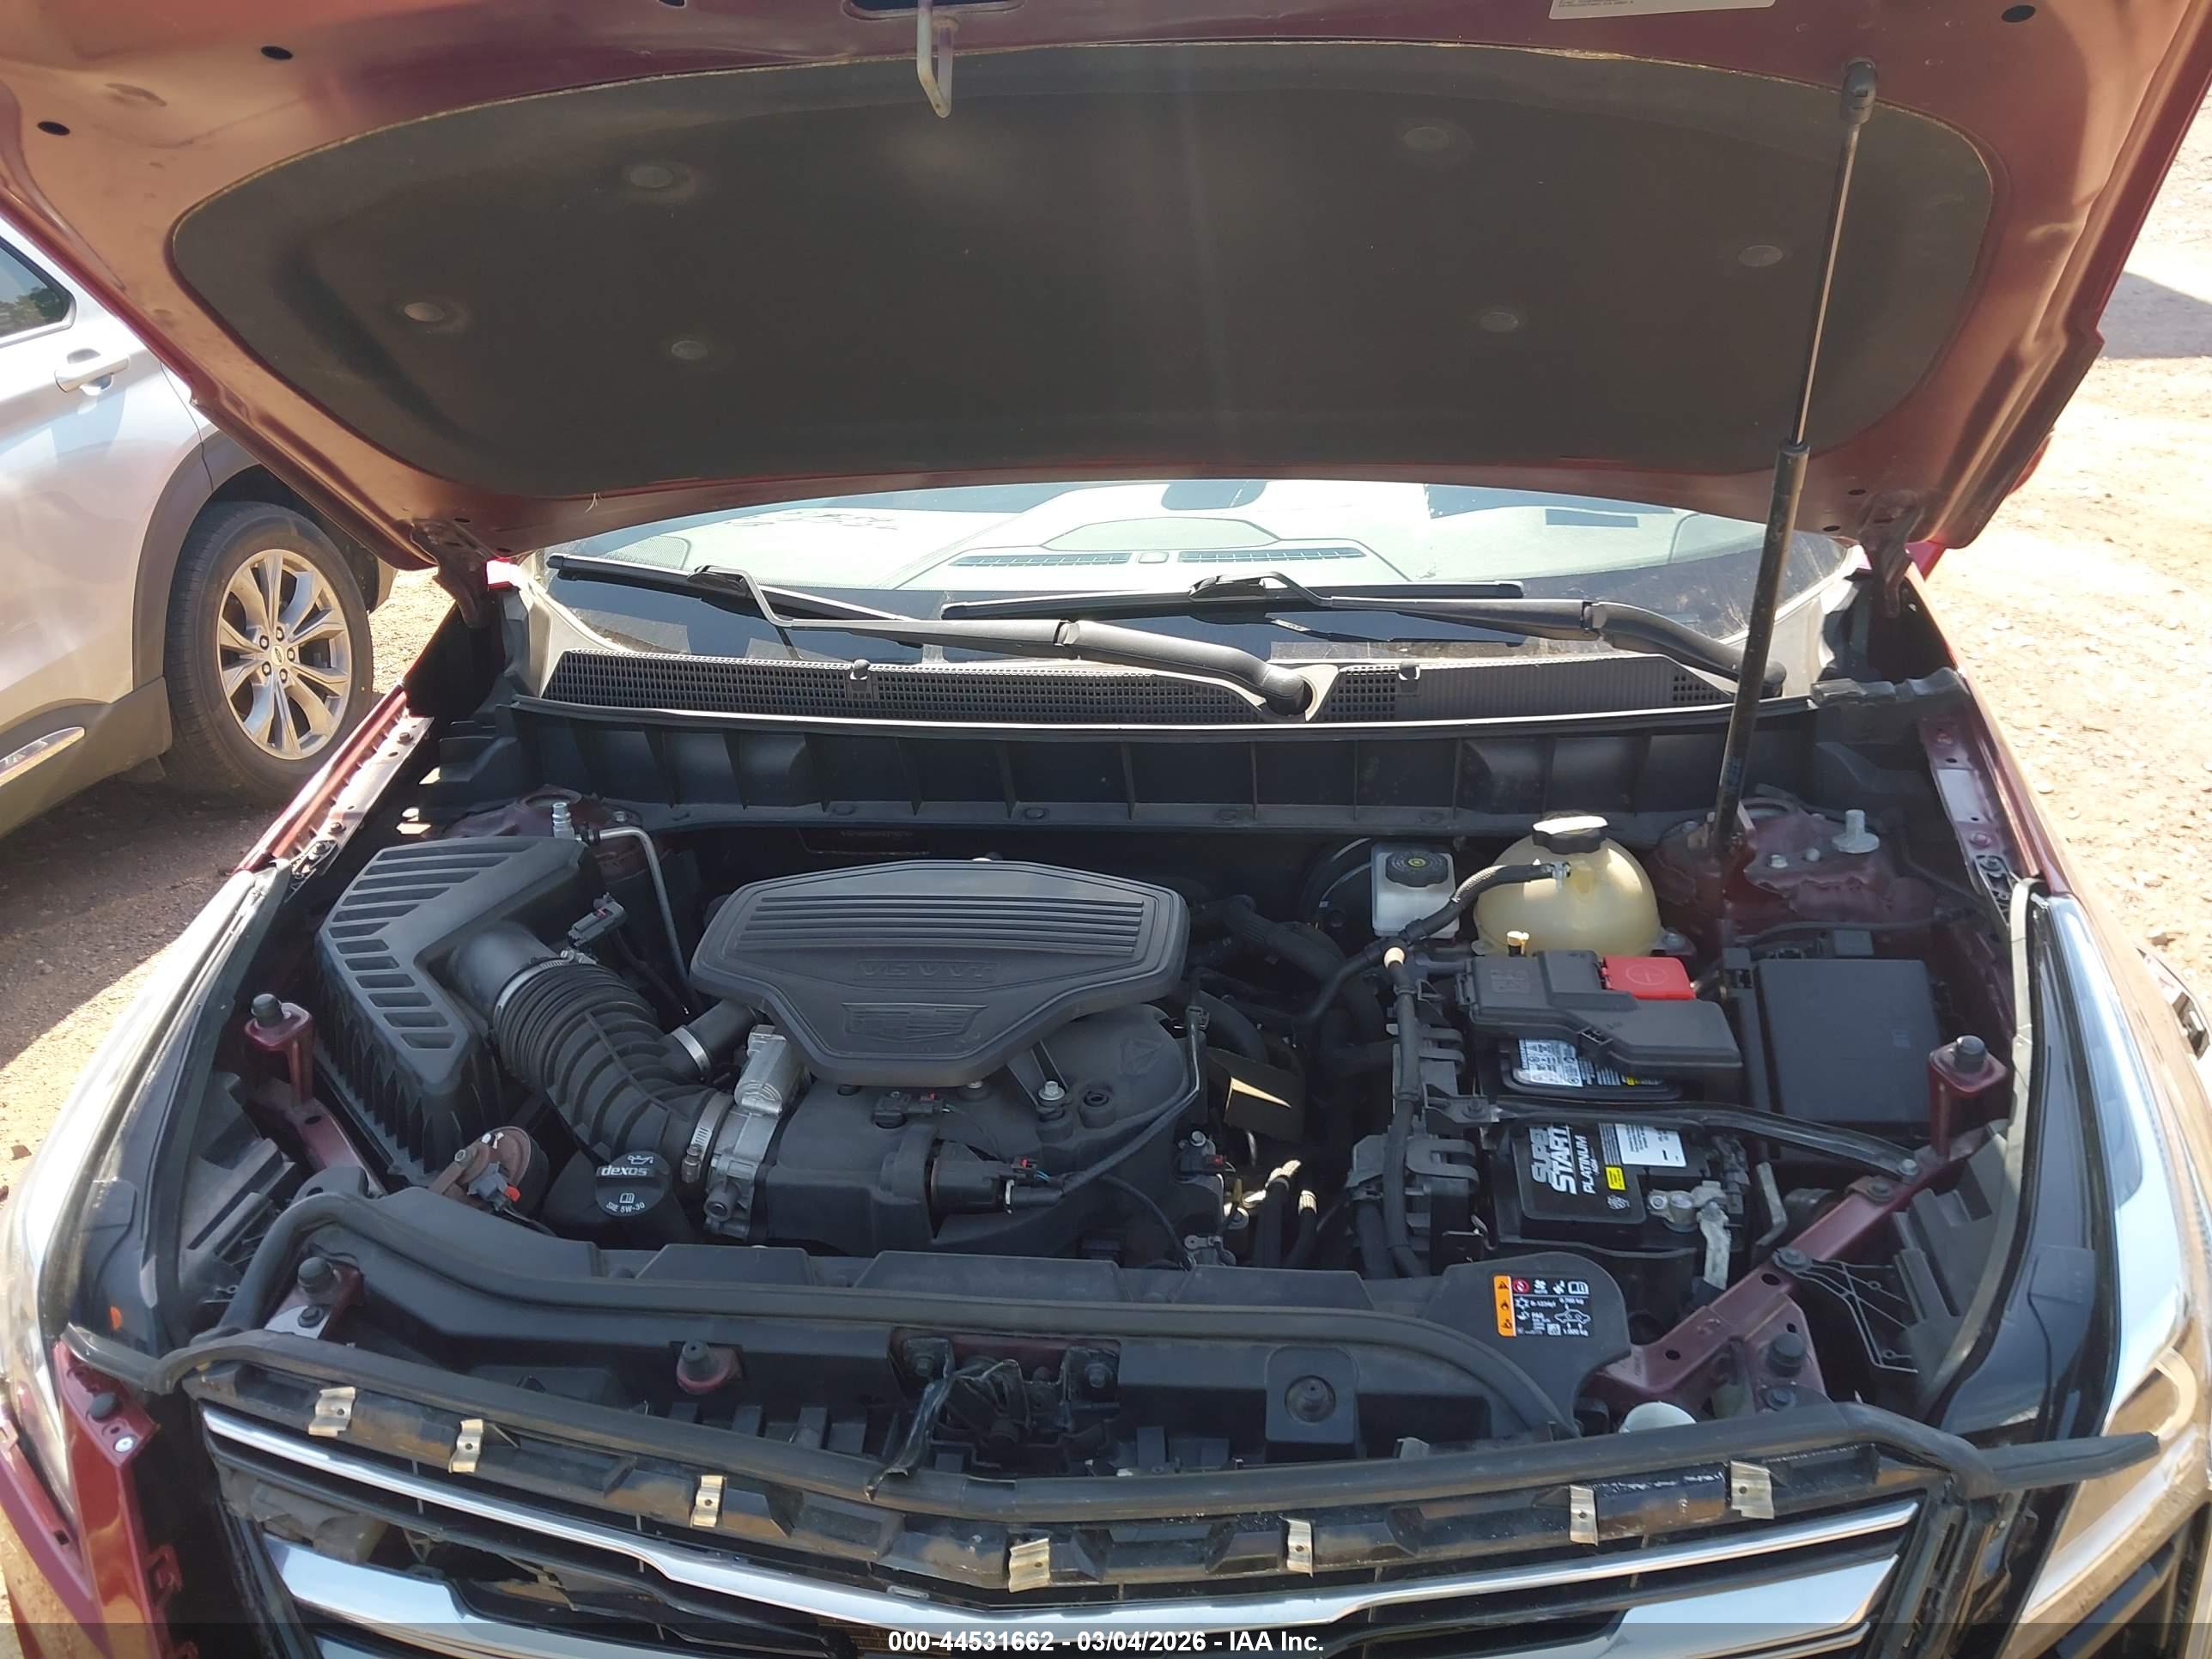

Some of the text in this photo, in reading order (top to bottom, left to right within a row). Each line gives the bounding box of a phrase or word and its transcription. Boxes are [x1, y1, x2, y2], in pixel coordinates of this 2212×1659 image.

[601, 1165, 648, 1176] dexos
[1529, 1127, 1552, 1183] SUPE
[1547, 1125, 1577, 1194] START
[1574, 1134, 1596, 1194] PLATINUM
